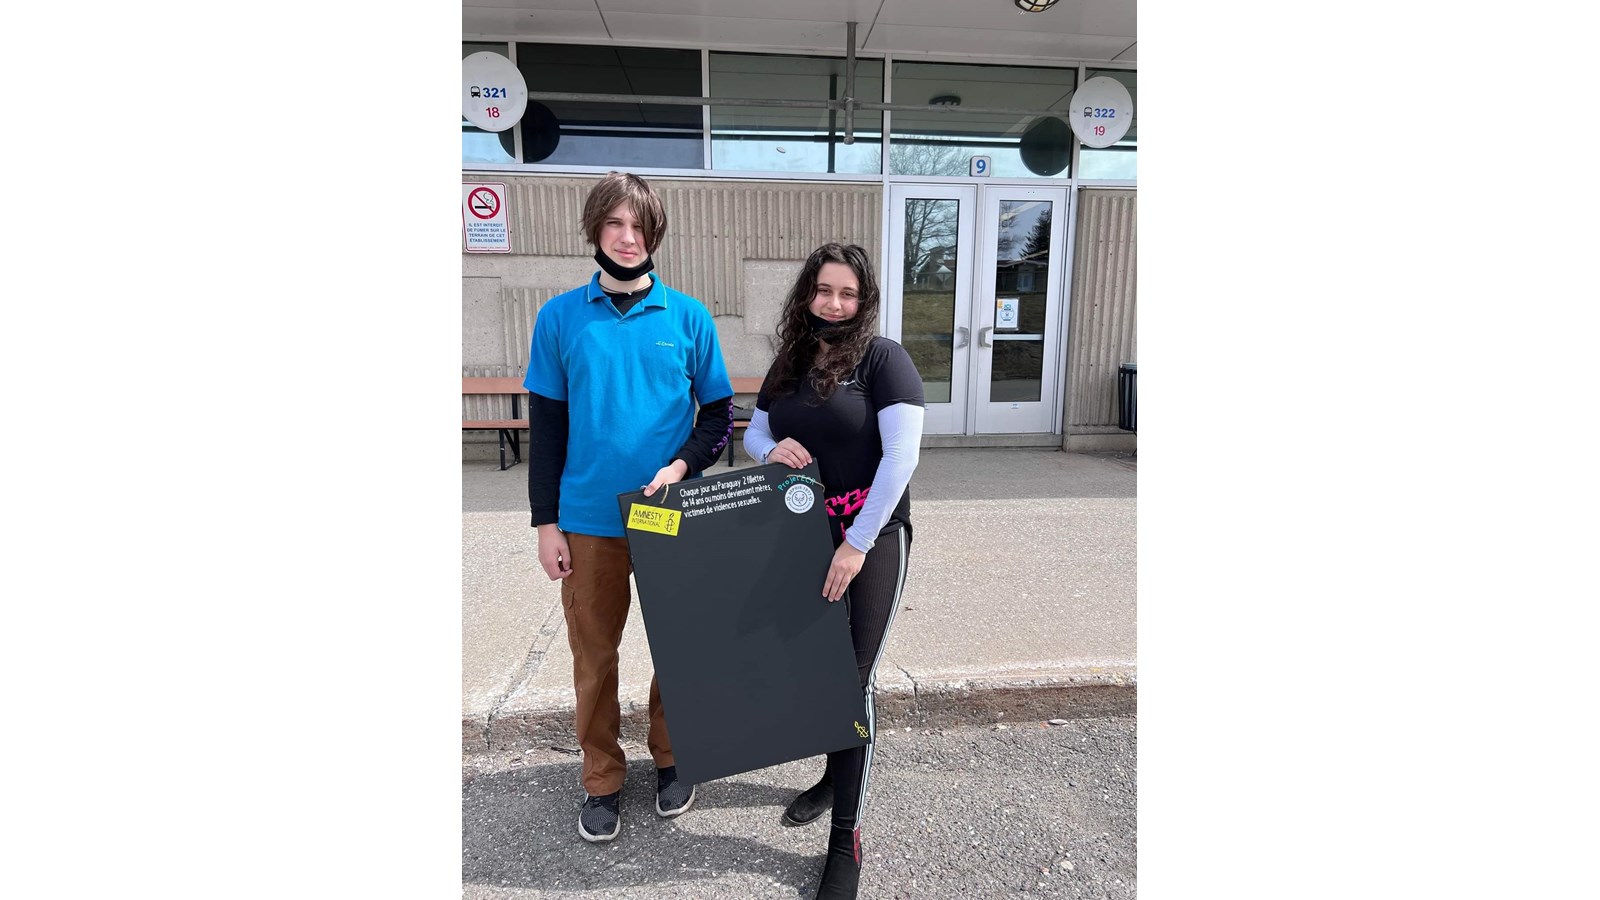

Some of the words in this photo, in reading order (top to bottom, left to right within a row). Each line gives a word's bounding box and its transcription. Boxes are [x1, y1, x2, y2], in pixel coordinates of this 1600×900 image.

[482, 87, 506, 99] 321
[485, 106, 500, 118] 18
[1094, 108, 1116, 118] 322
[1093, 125, 1106, 136] 19
[976, 159, 986, 174] 9
[679, 488, 699, 498] Chaque
[699, 486, 710, 496] jour
[711, 484, 717, 492] au
[717, 480, 741, 491] Paraguay
[742, 477, 747, 485] 2
[747, 475, 765, 484] fillettes
[682, 500, 689, 508] de
[695, 497, 704, 505] ans
[712, 493, 727, 502] moins
[727, 487, 754, 499] deviennent
[755, 484, 773, 493] mères,
[633, 509, 663, 521] AMNESTY
[683, 507, 706, 518] victimes
[706, 505, 713, 514] de
[713, 502, 737, 512] violences
[632, 518, 661, 528] INTERNATIONAL
